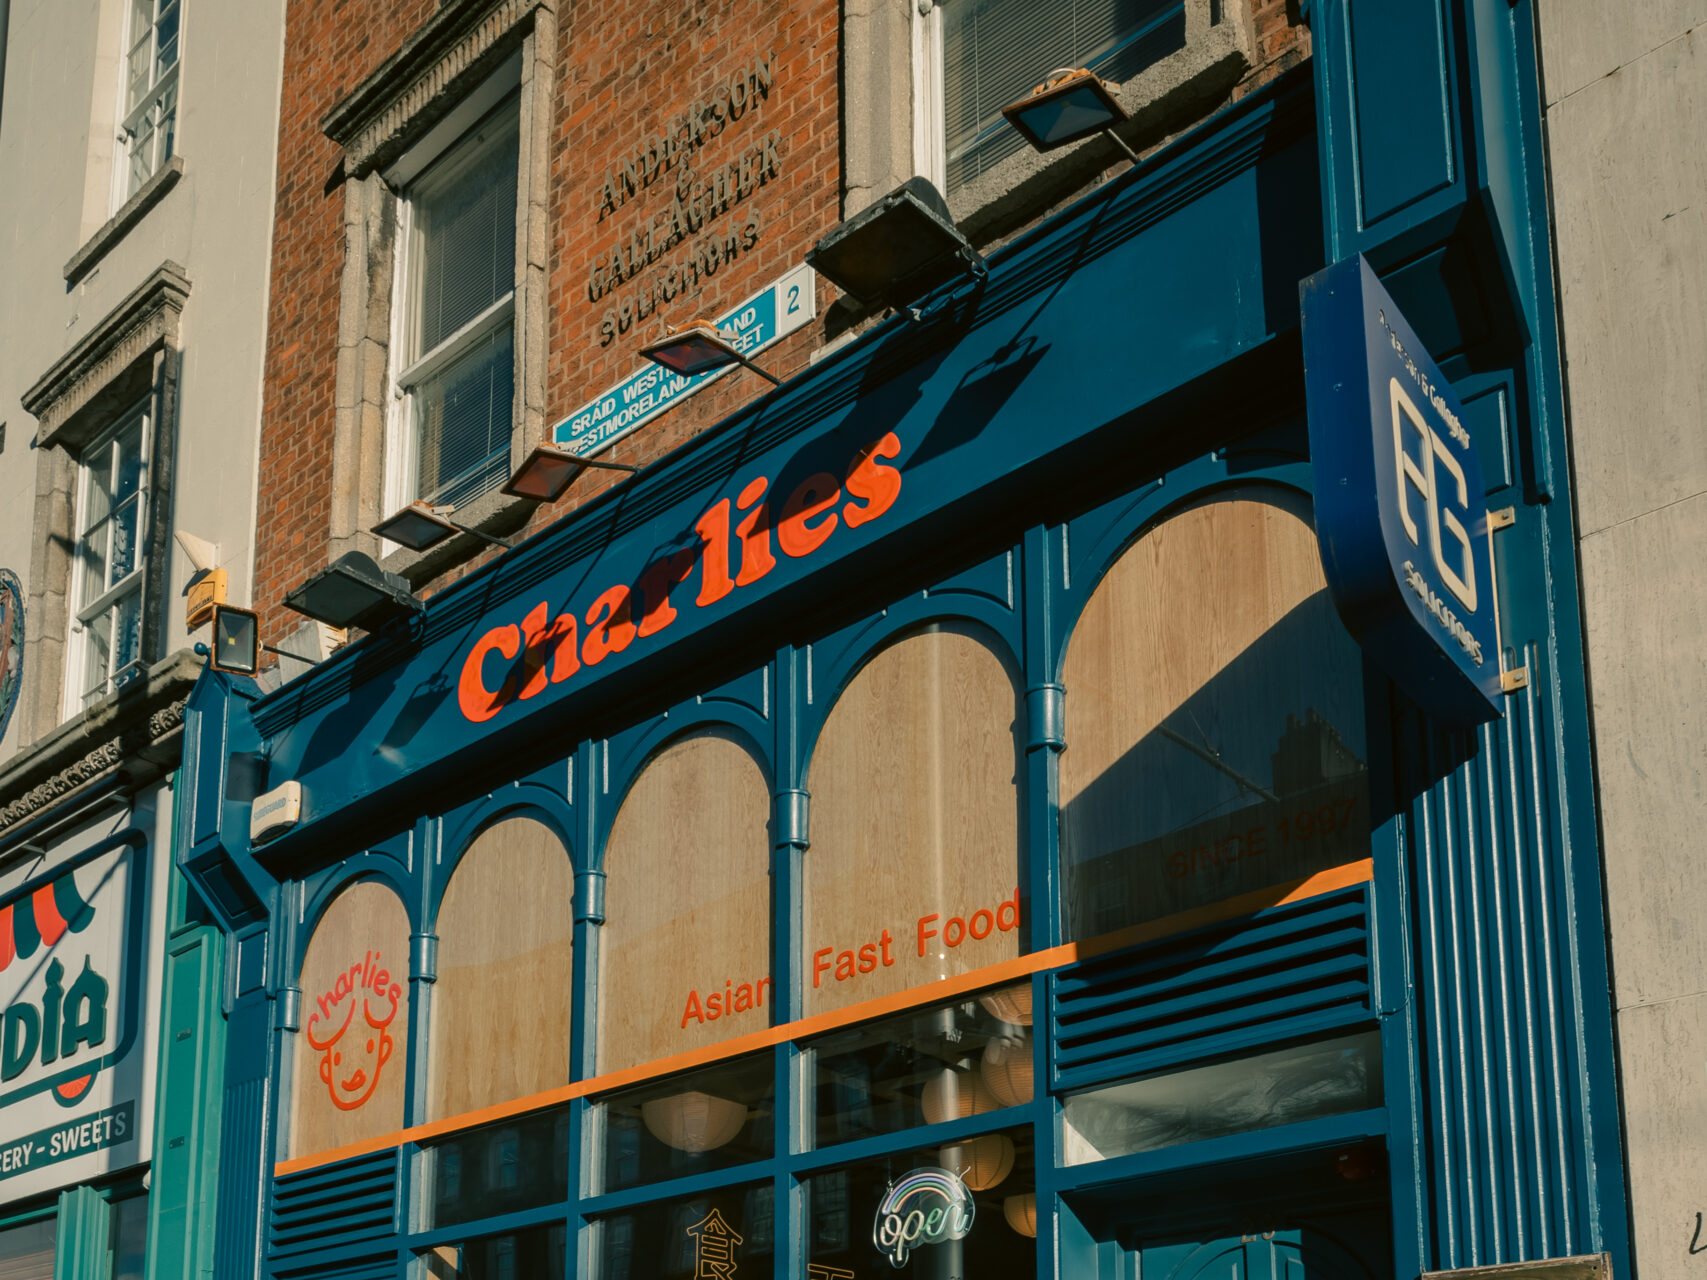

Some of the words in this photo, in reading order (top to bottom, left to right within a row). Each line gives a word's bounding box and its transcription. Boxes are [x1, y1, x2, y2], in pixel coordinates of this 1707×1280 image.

[599, 48, 776, 207] ANDERSON
[589, 127, 783, 292] GALLAGHER
[601, 208, 761, 336] SOLICITORS
[787, 285, 800, 315] 2
[571, 397, 617, 437] SRÁID
[573, 376, 692, 453] ESTMORELAND
[457, 431, 902, 723] Charlies
[1168, 825, 1269, 880] SINCE
[1276, 796, 1358, 846] 1997
[813, 929, 896, 989] Fast
[917, 887, 1022, 957] Food
[0, 954, 109, 1083] DIA
[0, 1141, 34, 1173] ERY
[50, 1111, 127, 1157] SWEETS
[880, 1204, 970, 1262] open
